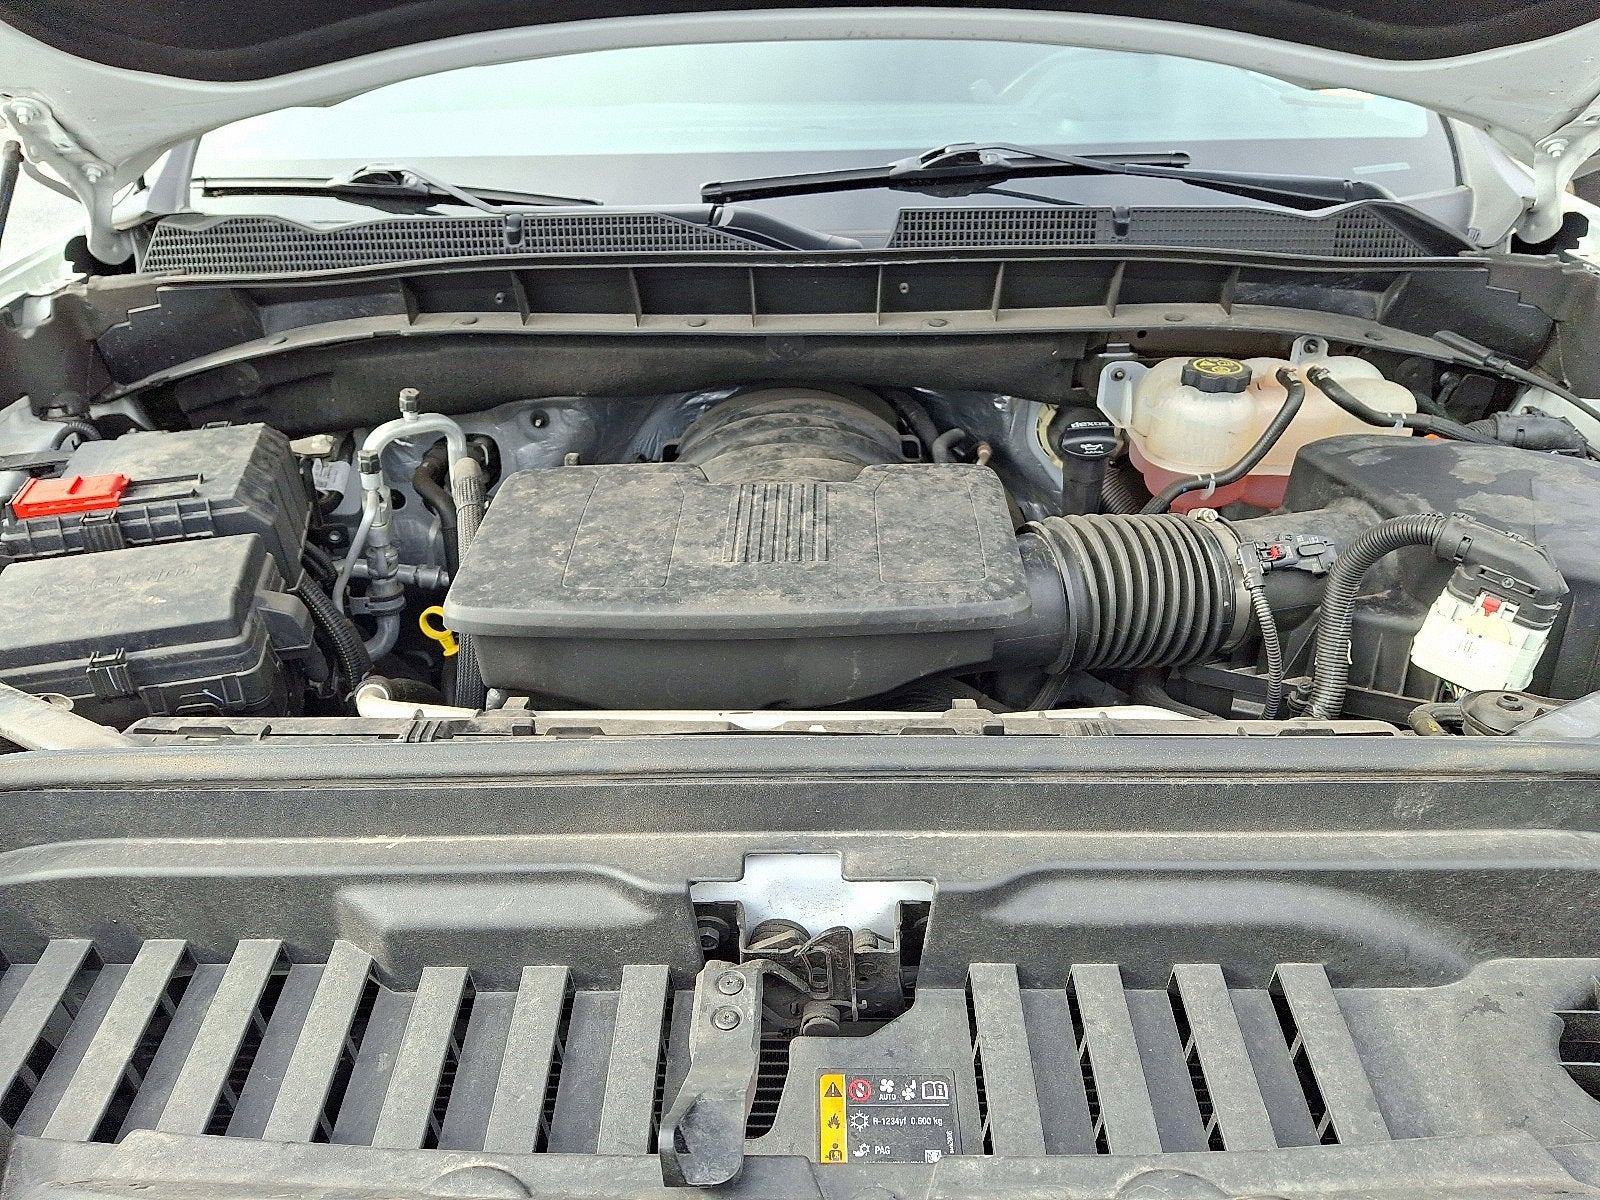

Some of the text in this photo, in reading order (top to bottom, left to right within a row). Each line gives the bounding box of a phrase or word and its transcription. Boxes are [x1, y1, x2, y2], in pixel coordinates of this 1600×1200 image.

[879, 1093, 897, 1101] AUTO
[872, 1117, 907, 1127] R-1234yf
[933, 1116, 943, 1127] kg
[874, 1146, 891, 1155] PAG
